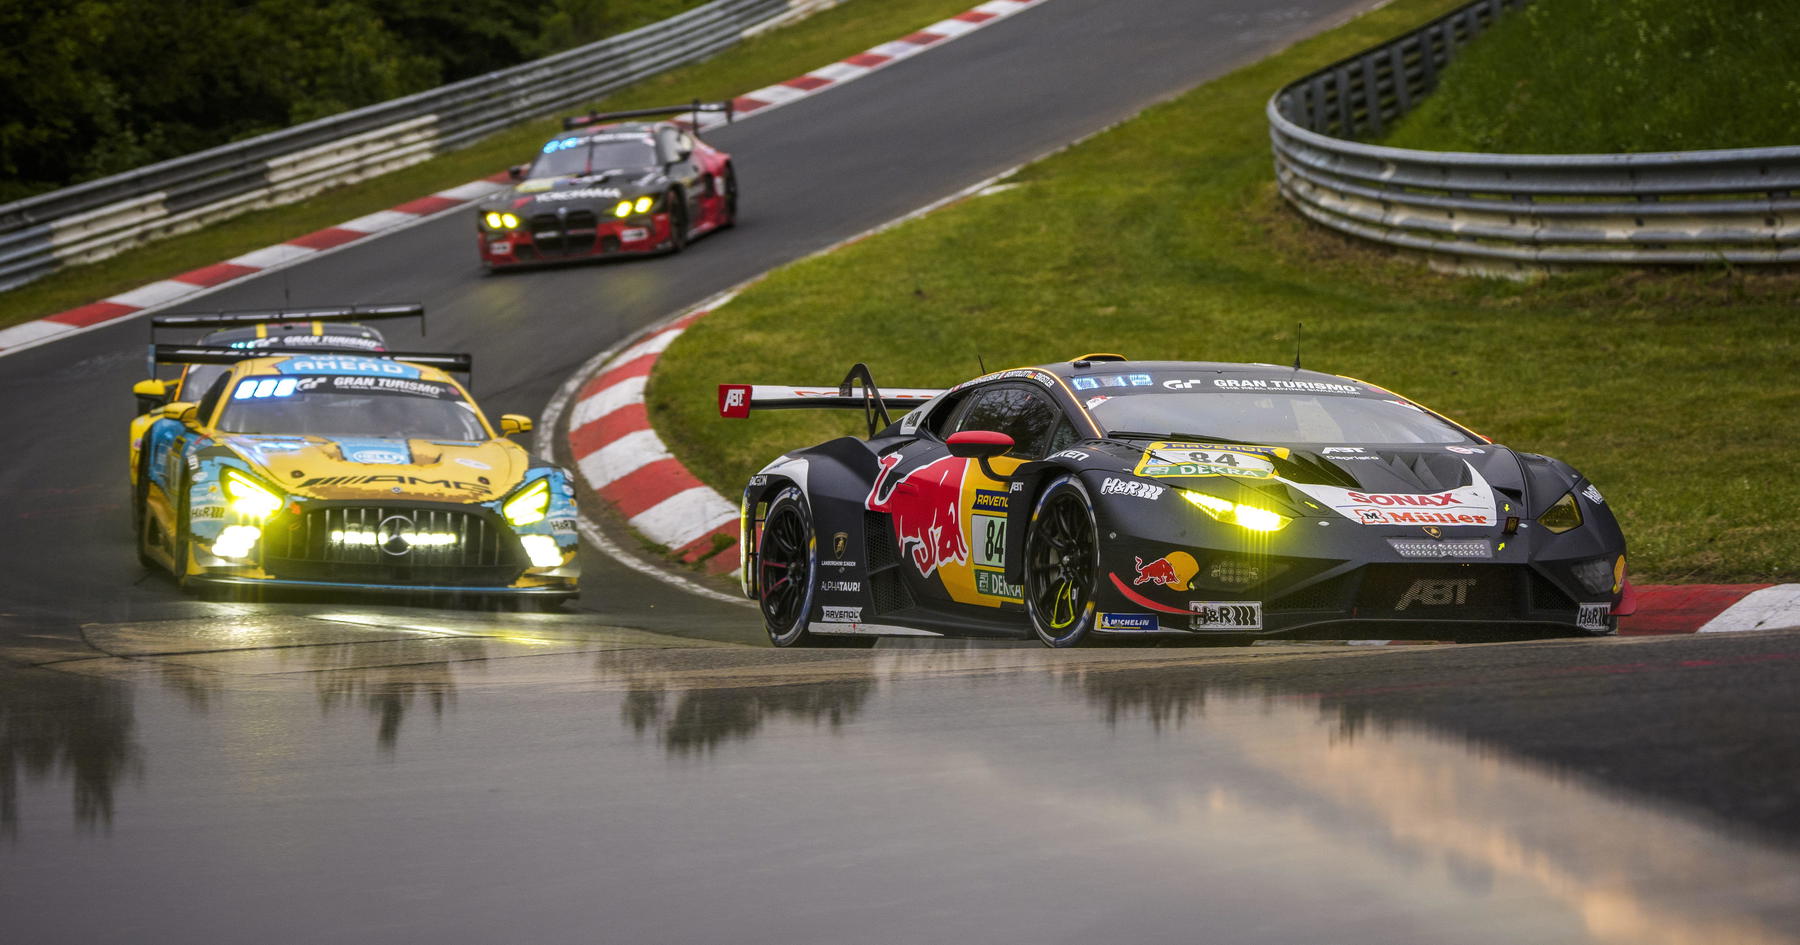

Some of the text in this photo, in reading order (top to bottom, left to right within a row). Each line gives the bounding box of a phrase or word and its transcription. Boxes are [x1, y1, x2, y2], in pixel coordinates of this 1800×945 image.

[284, 336, 320, 345] GRAN
[323, 336, 377, 347] TURISMO
[294, 361, 403, 374] AHEAD
[333, 377, 376, 387] GRAN
[378, 378, 440, 395] TURISMO
[1213, 379, 1267, 387] GRAN
[1271, 380, 1356, 393] TURISMO
[723, 389, 745, 412] ABT
[1189, 452, 1239, 467] 84
[1180, 465, 1259, 477] DEKRA
[361, 475, 493, 495] AMG
[1009, 482, 1024, 493] ABT
[1101, 477, 1140, 497] H&R
[1347, 492, 1462, 506] SONAX
[1388, 512, 1487, 524] Müller
[985, 519, 1006, 563] 84
[1395, 578, 1477, 611] ABT
[825, 610, 859, 618] RAVENOL
[1193, 605, 1231, 626] H&R
